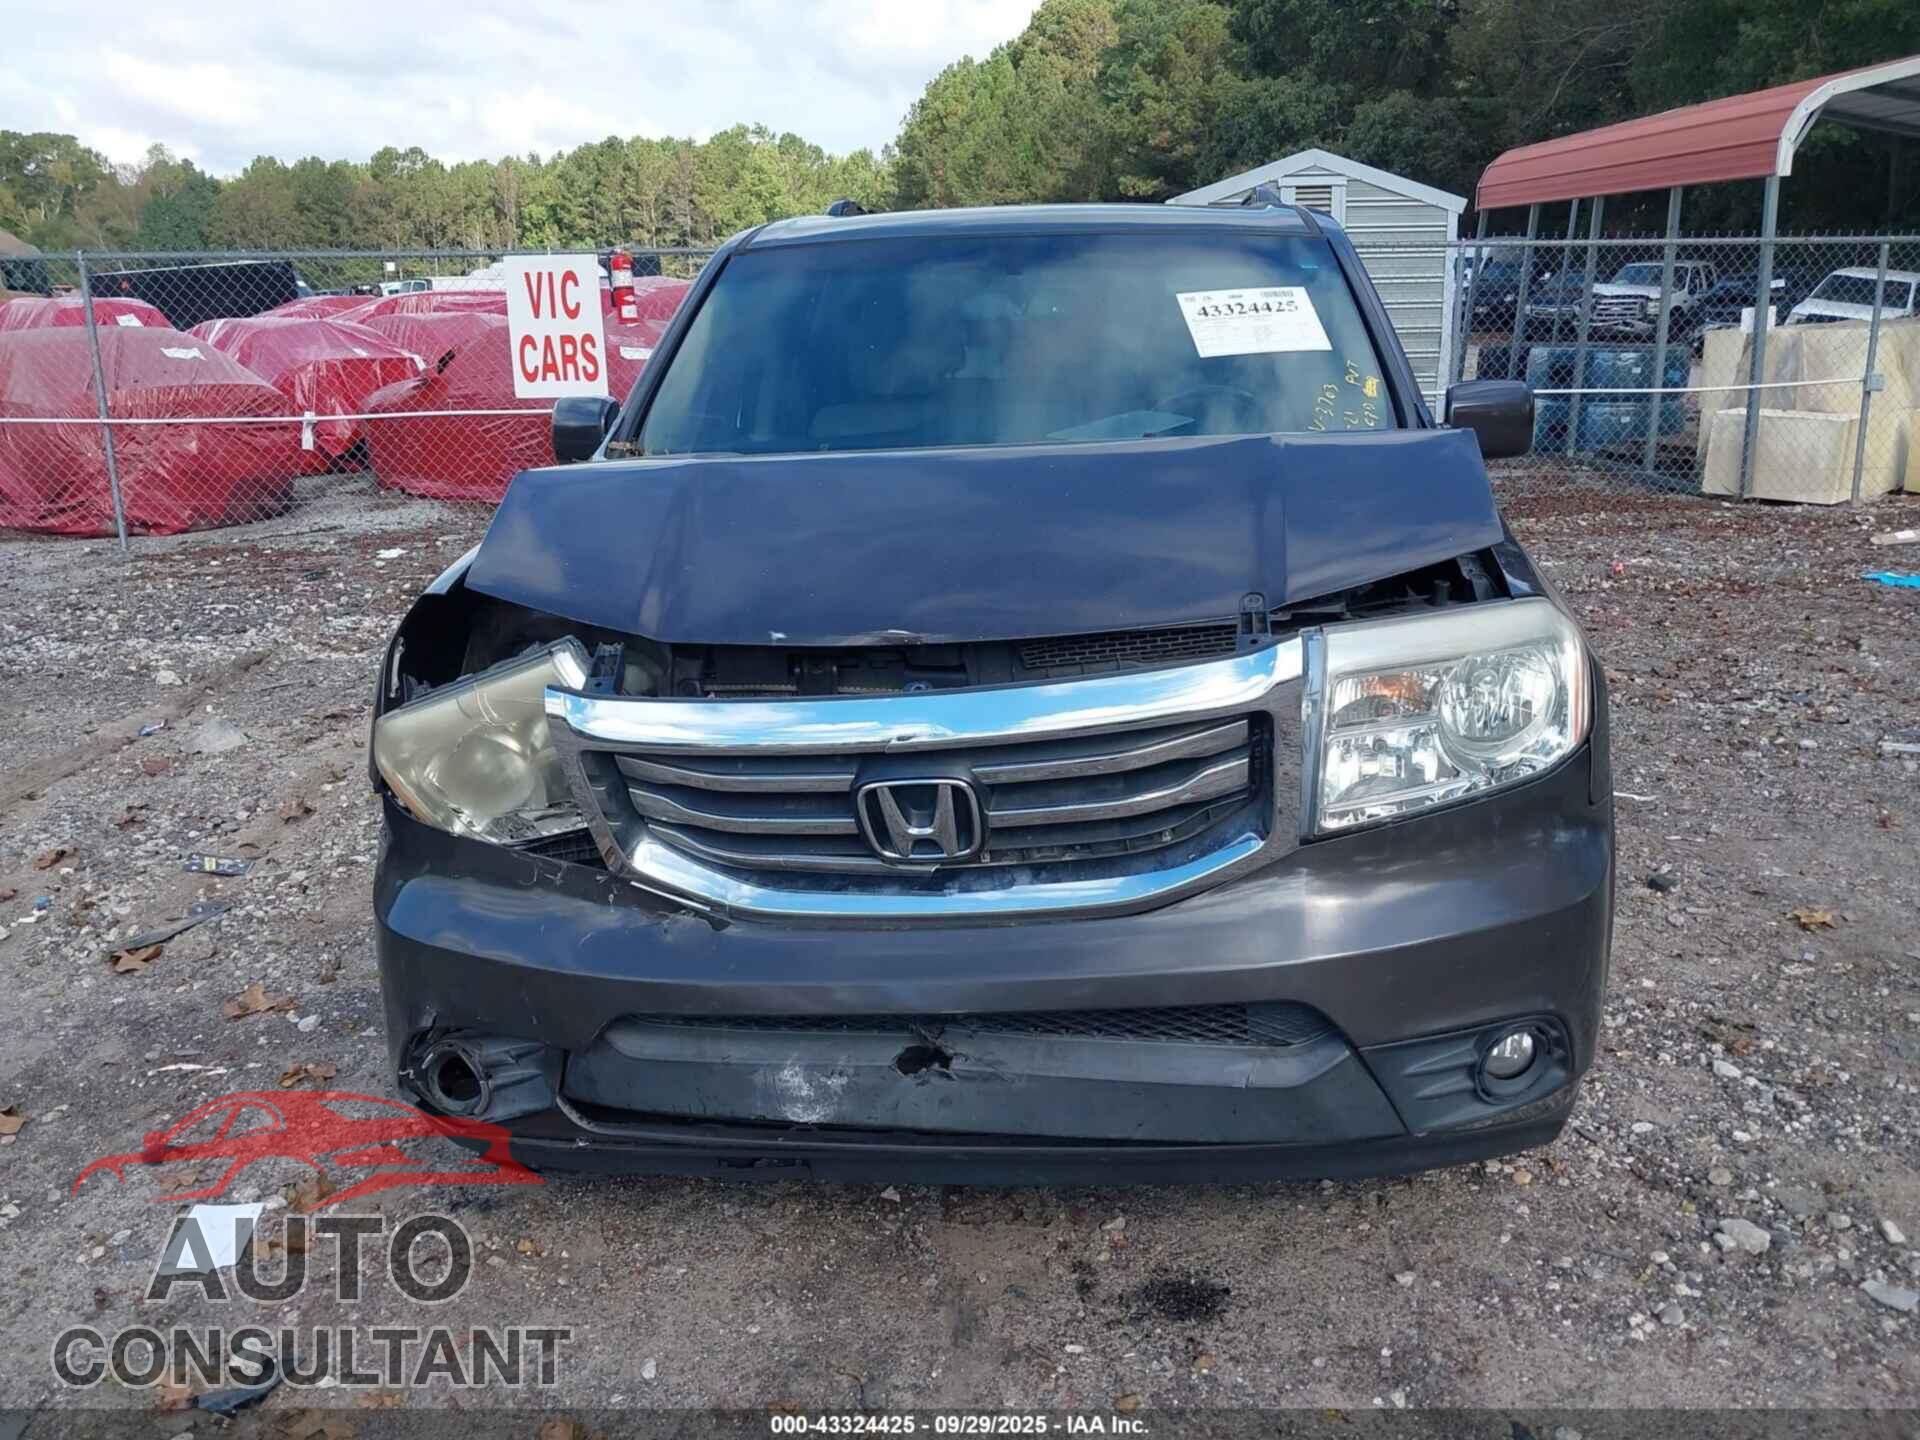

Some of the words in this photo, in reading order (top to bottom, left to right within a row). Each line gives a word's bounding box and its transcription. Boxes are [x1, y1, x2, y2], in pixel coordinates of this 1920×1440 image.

[524, 270, 581, 320] VIC
[1197, 300, 1299, 318] 43324425
[519, 333, 599, 383] CARS
